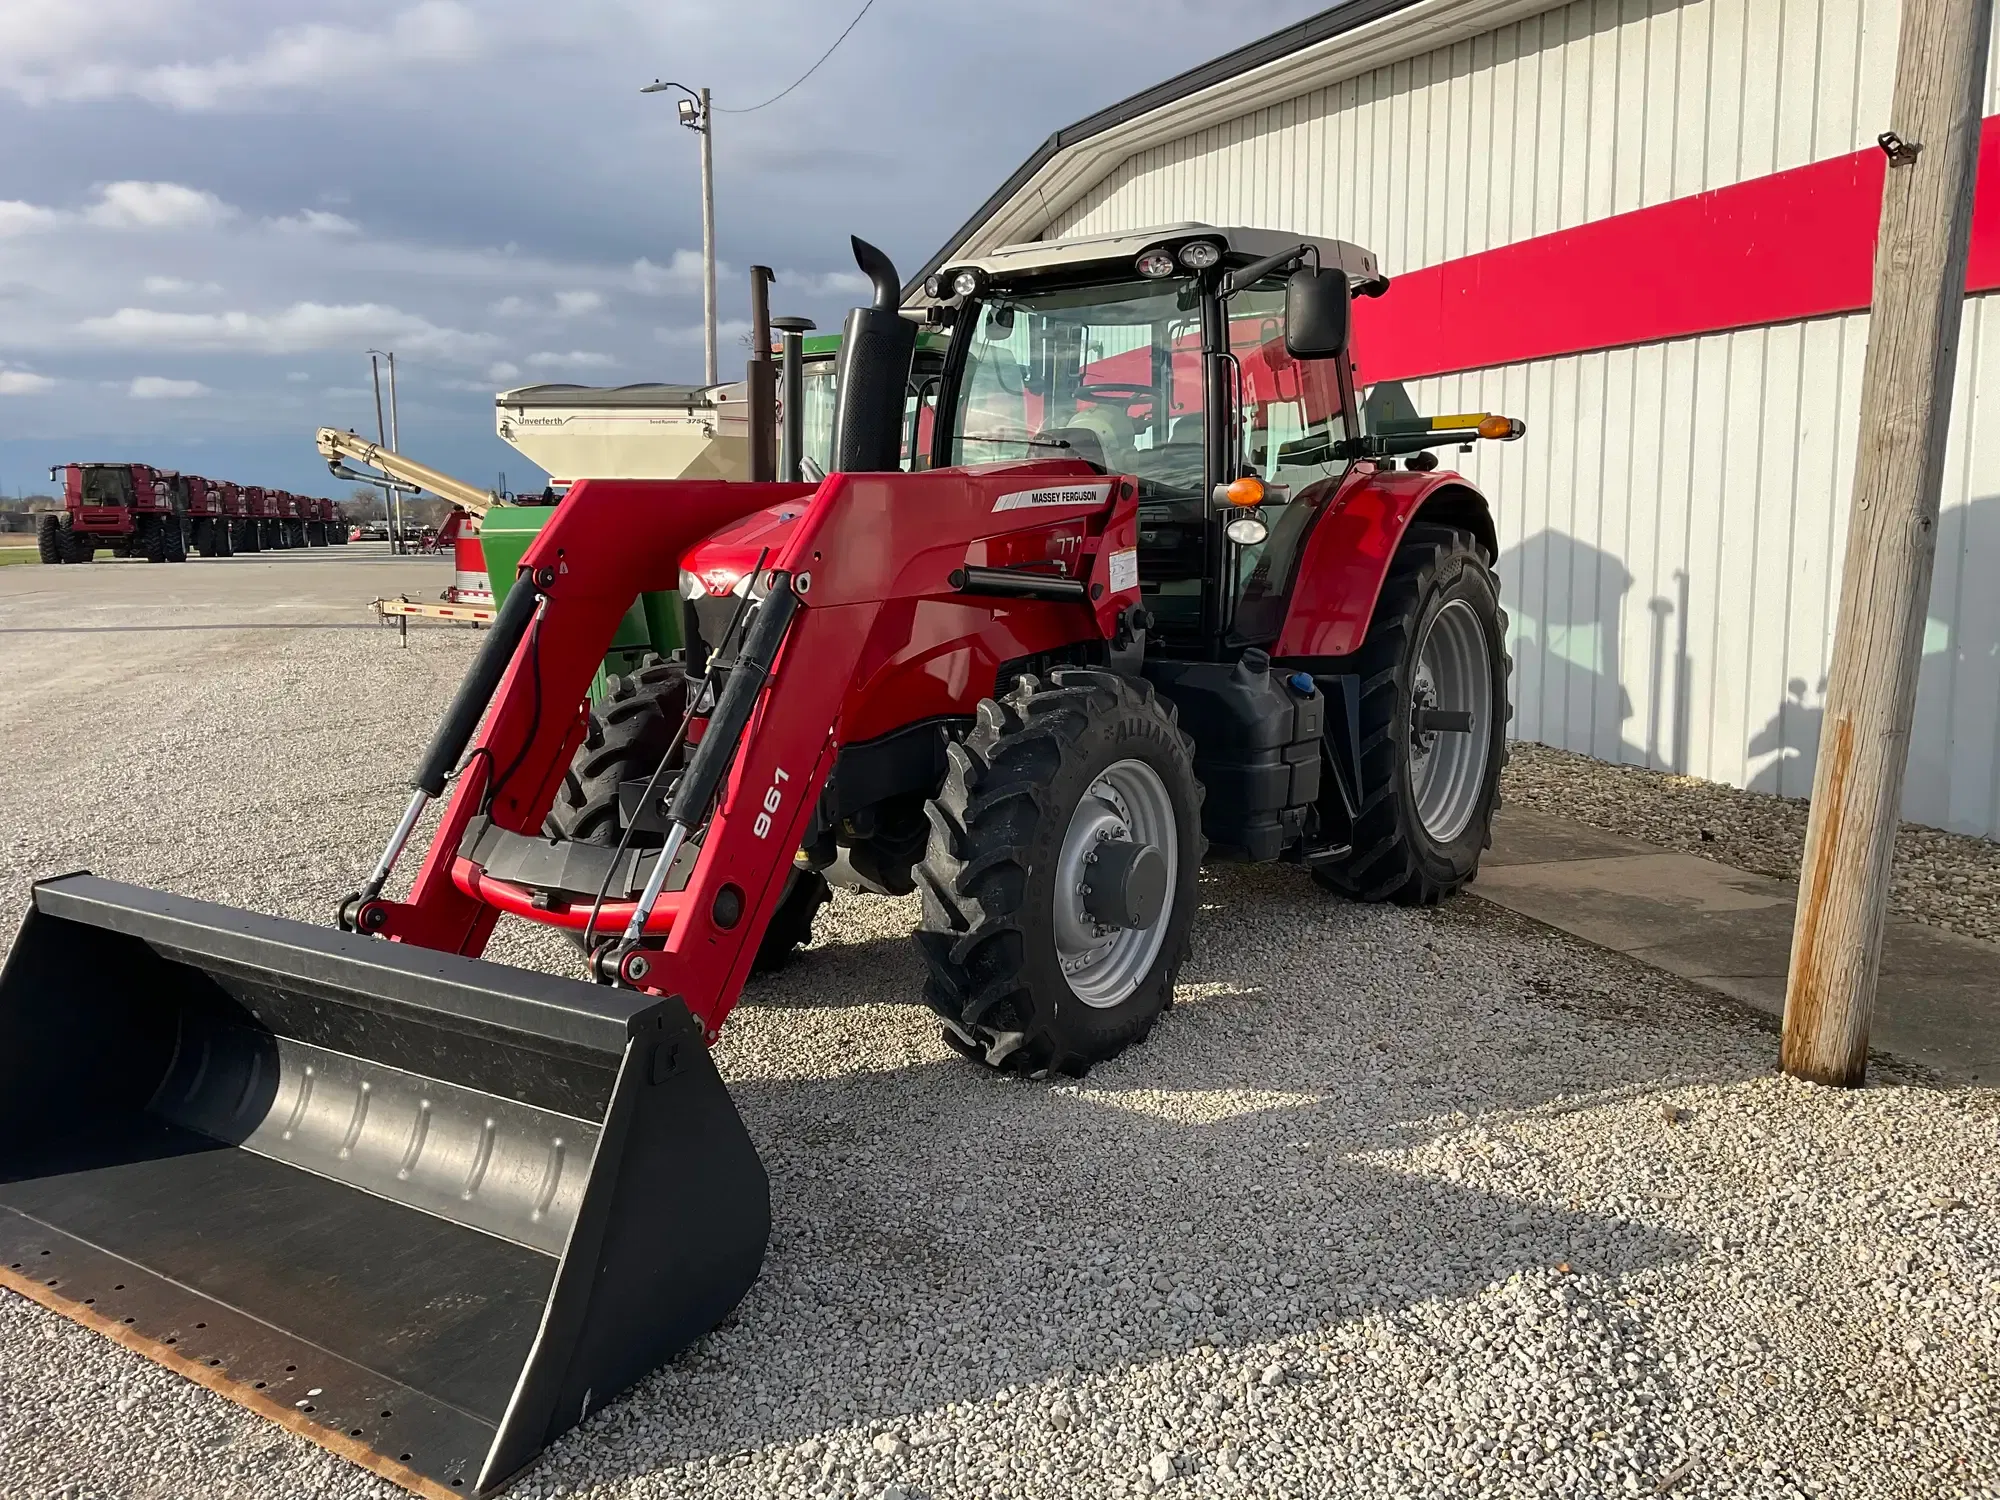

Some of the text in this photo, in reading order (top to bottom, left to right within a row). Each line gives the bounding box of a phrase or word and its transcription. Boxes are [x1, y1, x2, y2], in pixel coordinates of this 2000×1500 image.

[518, 416, 563, 425] Unverferth
[1031, 491, 1097, 503] MASSEY FERGUSON
[753, 767, 790, 840] 961
